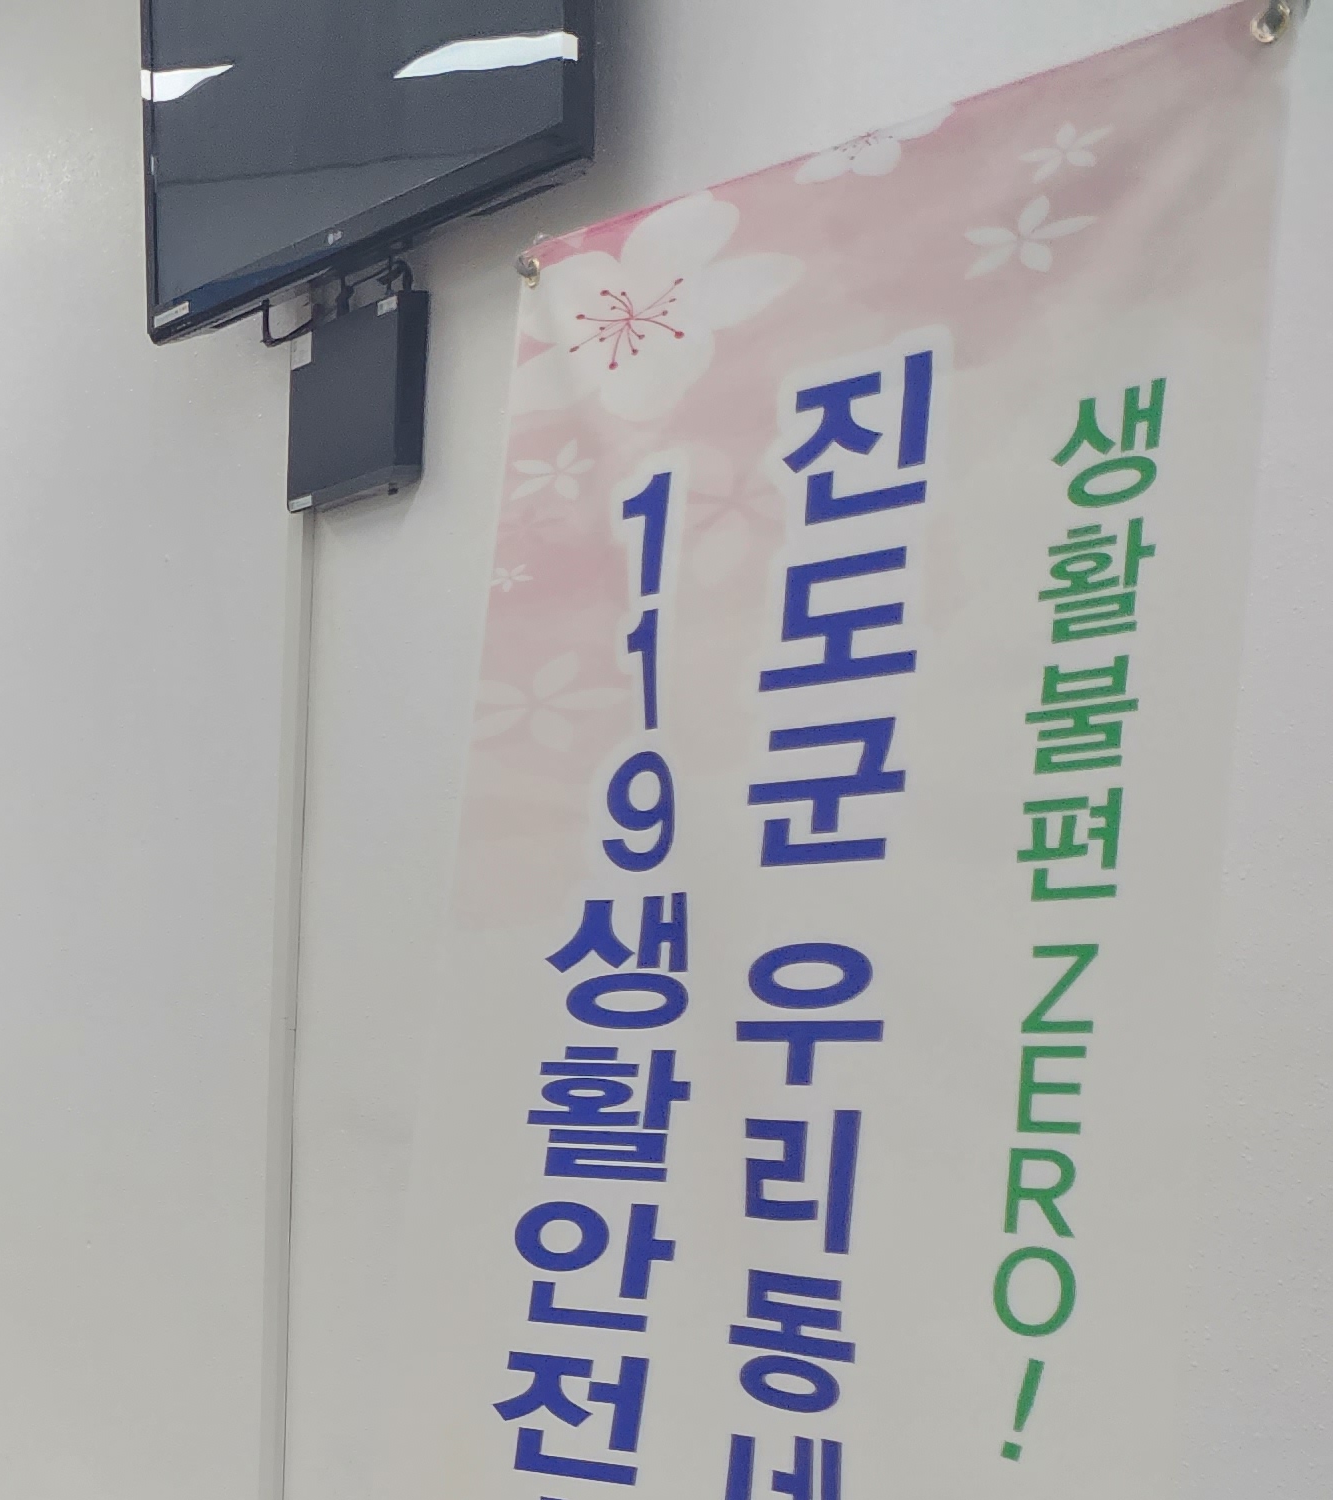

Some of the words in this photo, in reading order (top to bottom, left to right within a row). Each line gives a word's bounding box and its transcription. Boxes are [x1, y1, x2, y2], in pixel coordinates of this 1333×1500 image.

[748, 350, 933, 867] 진도군
[1017, 377, 1167, 902] 생활불편
[992, 944, 1099, 1462] ZERO!
